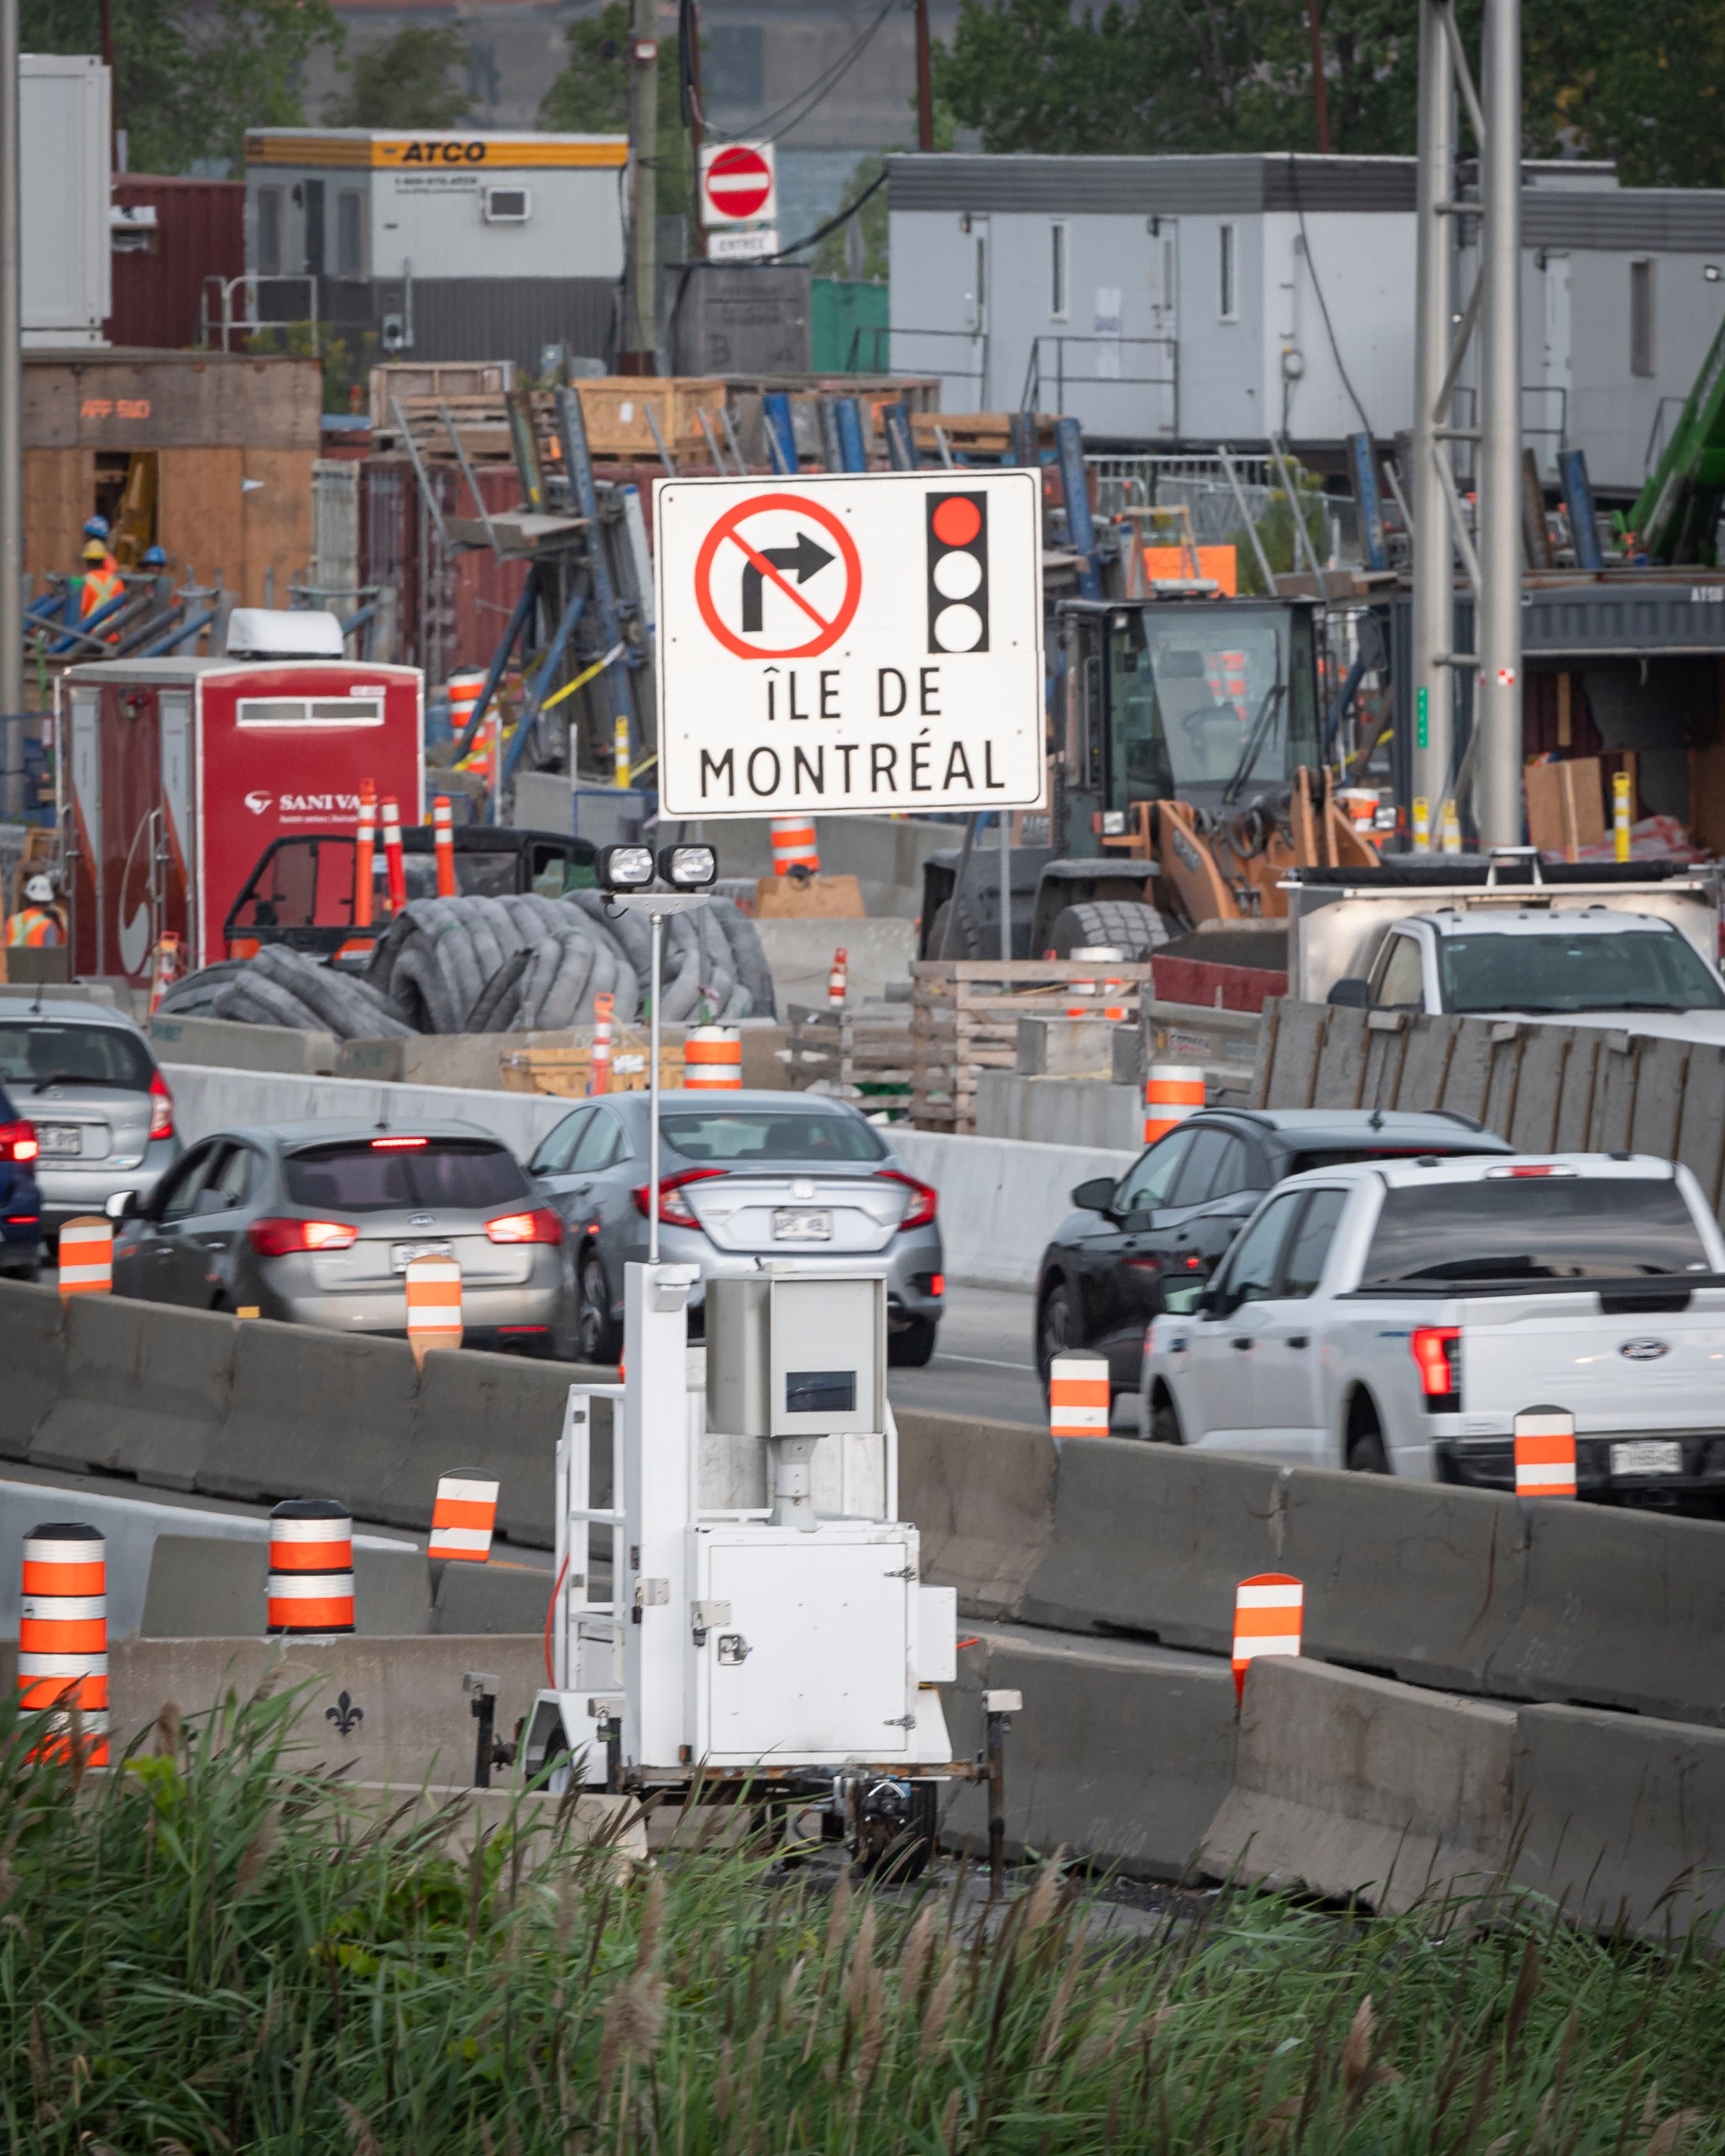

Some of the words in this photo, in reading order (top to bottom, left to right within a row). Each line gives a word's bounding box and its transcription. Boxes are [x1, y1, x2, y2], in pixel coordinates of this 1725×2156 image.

[402, 141, 486, 163] ATCO
[764, 666, 841, 720] ÎLE
[878, 667, 942, 716] DE
[699, 728, 1005, 797] MONTRÉAL
[279, 794, 378, 810] SANIVA
